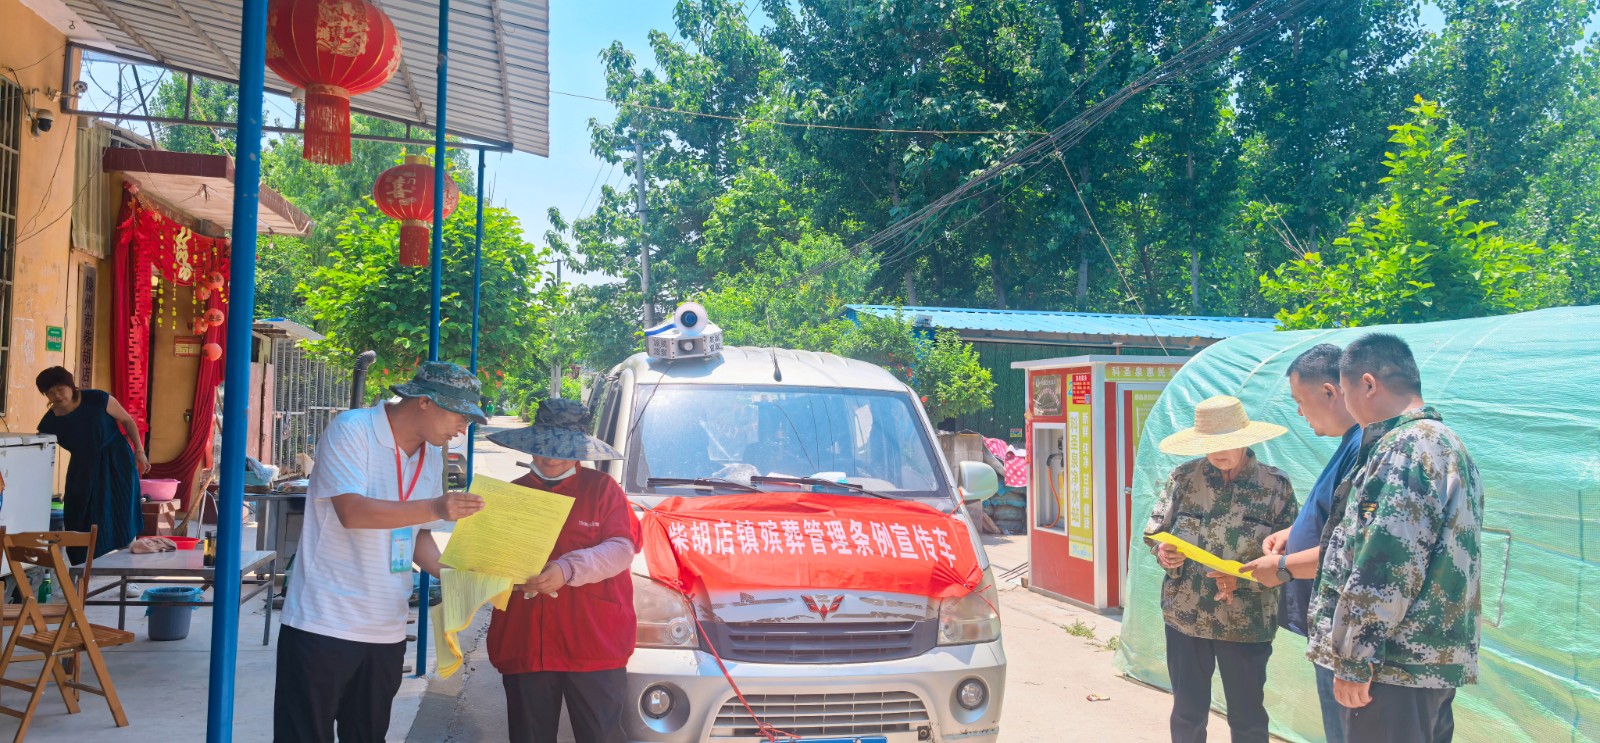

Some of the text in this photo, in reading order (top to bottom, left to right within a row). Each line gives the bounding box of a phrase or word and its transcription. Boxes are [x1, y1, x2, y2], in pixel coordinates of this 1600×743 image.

[81, 276, 94, 389] 滕州市柴胡店
[668, 518, 957, 569] 柴胡店镇殡葬管理条例宣传车
